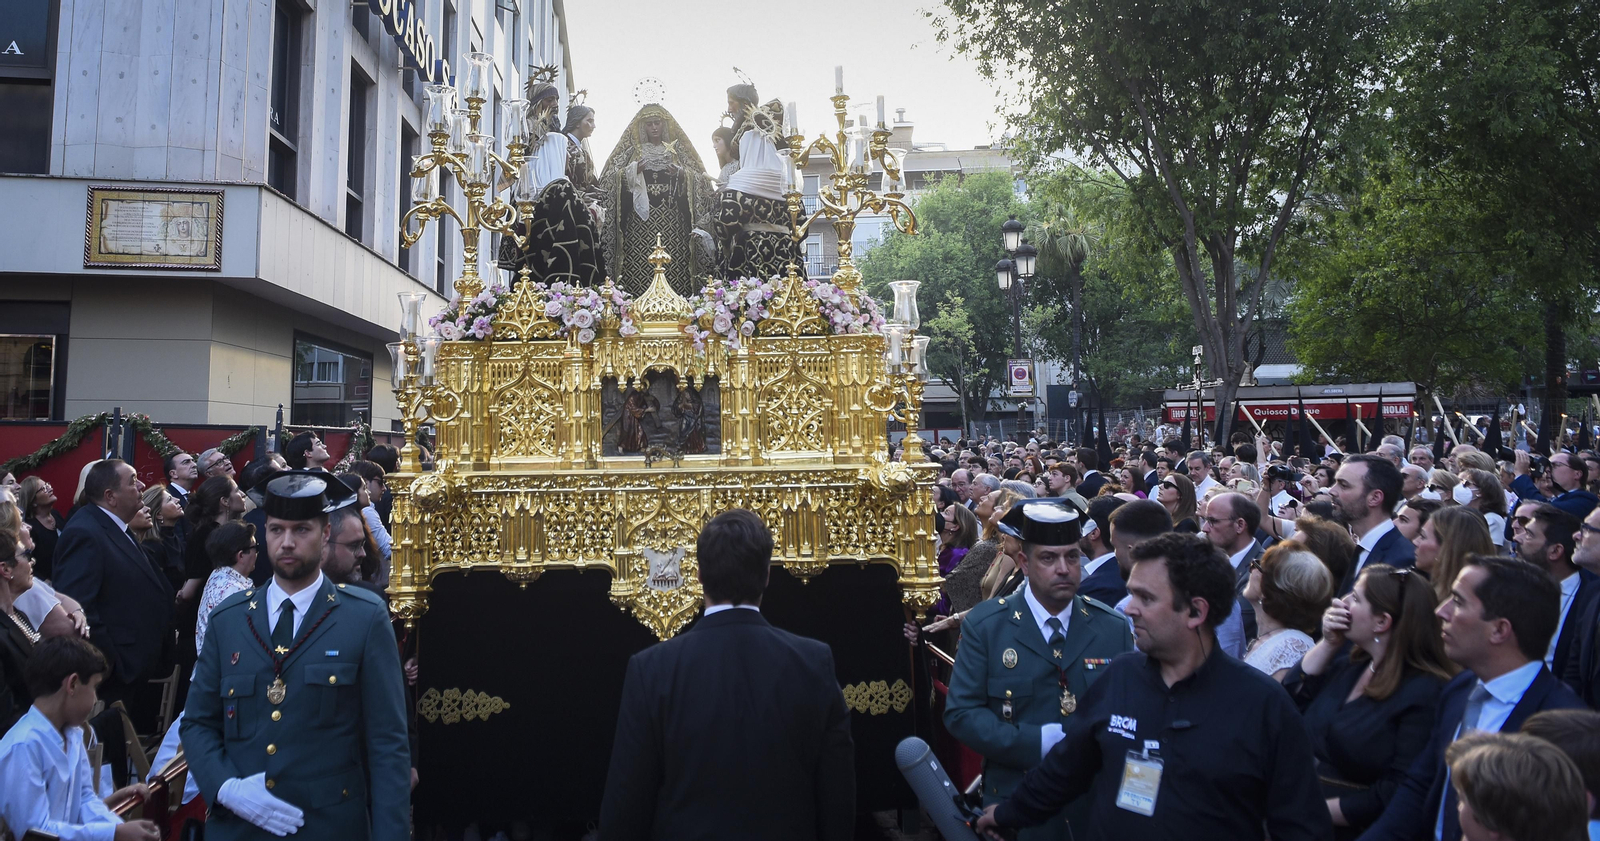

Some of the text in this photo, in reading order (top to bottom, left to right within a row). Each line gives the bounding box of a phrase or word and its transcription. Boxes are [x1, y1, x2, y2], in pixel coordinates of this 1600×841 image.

[1, 40, 25, 55] A
[1172, 409, 1197, 418] ¡HOA!
[1254, 408, 1288, 416] Quiosco
[1110, 714, 1137, 732] BRCM
